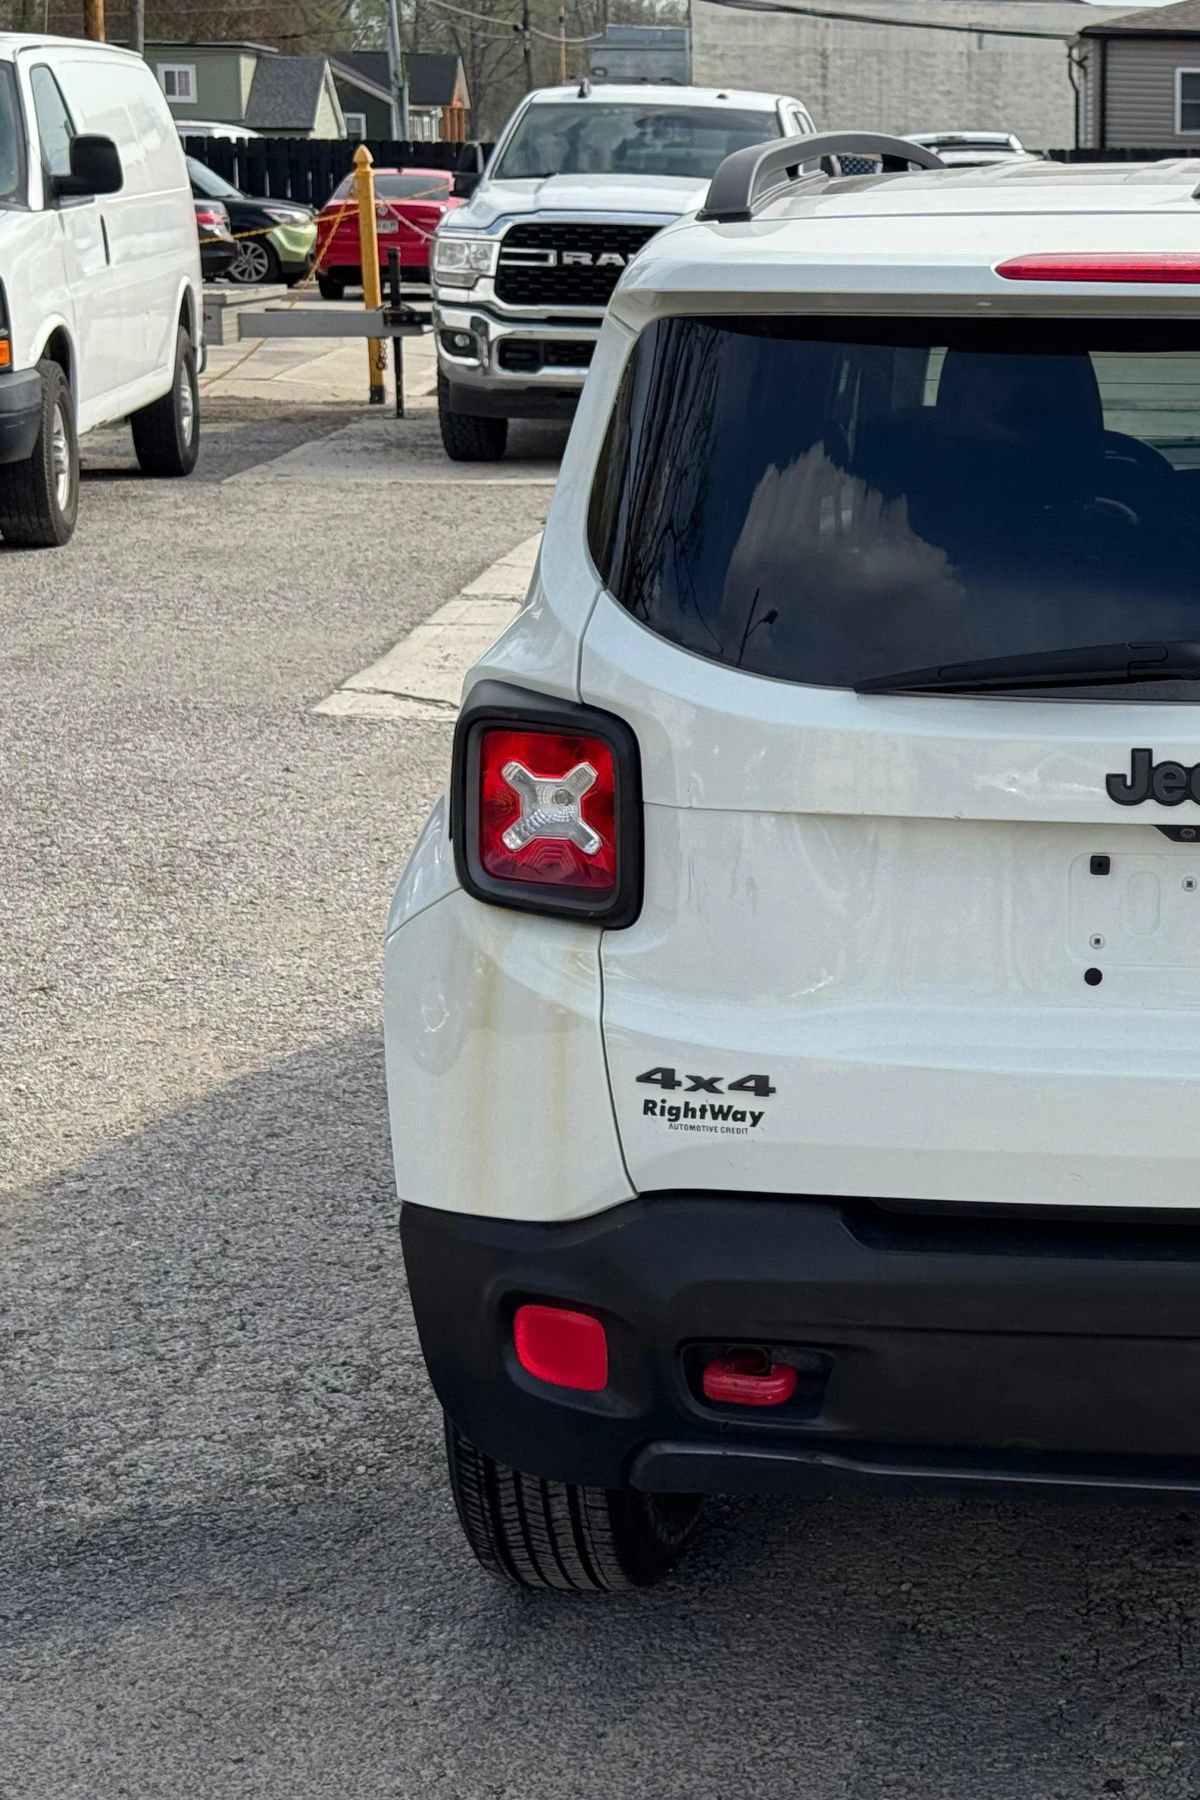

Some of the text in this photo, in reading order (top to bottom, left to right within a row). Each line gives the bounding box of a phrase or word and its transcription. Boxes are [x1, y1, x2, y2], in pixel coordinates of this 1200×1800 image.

[562, 251, 636, 267] RA
[636, 1066, 776, 1097] 4x4
[642, 1099, 765, 1127] RightWay
[668, 1122, 749, 1136] AUTOMOTIVE CREDIT
